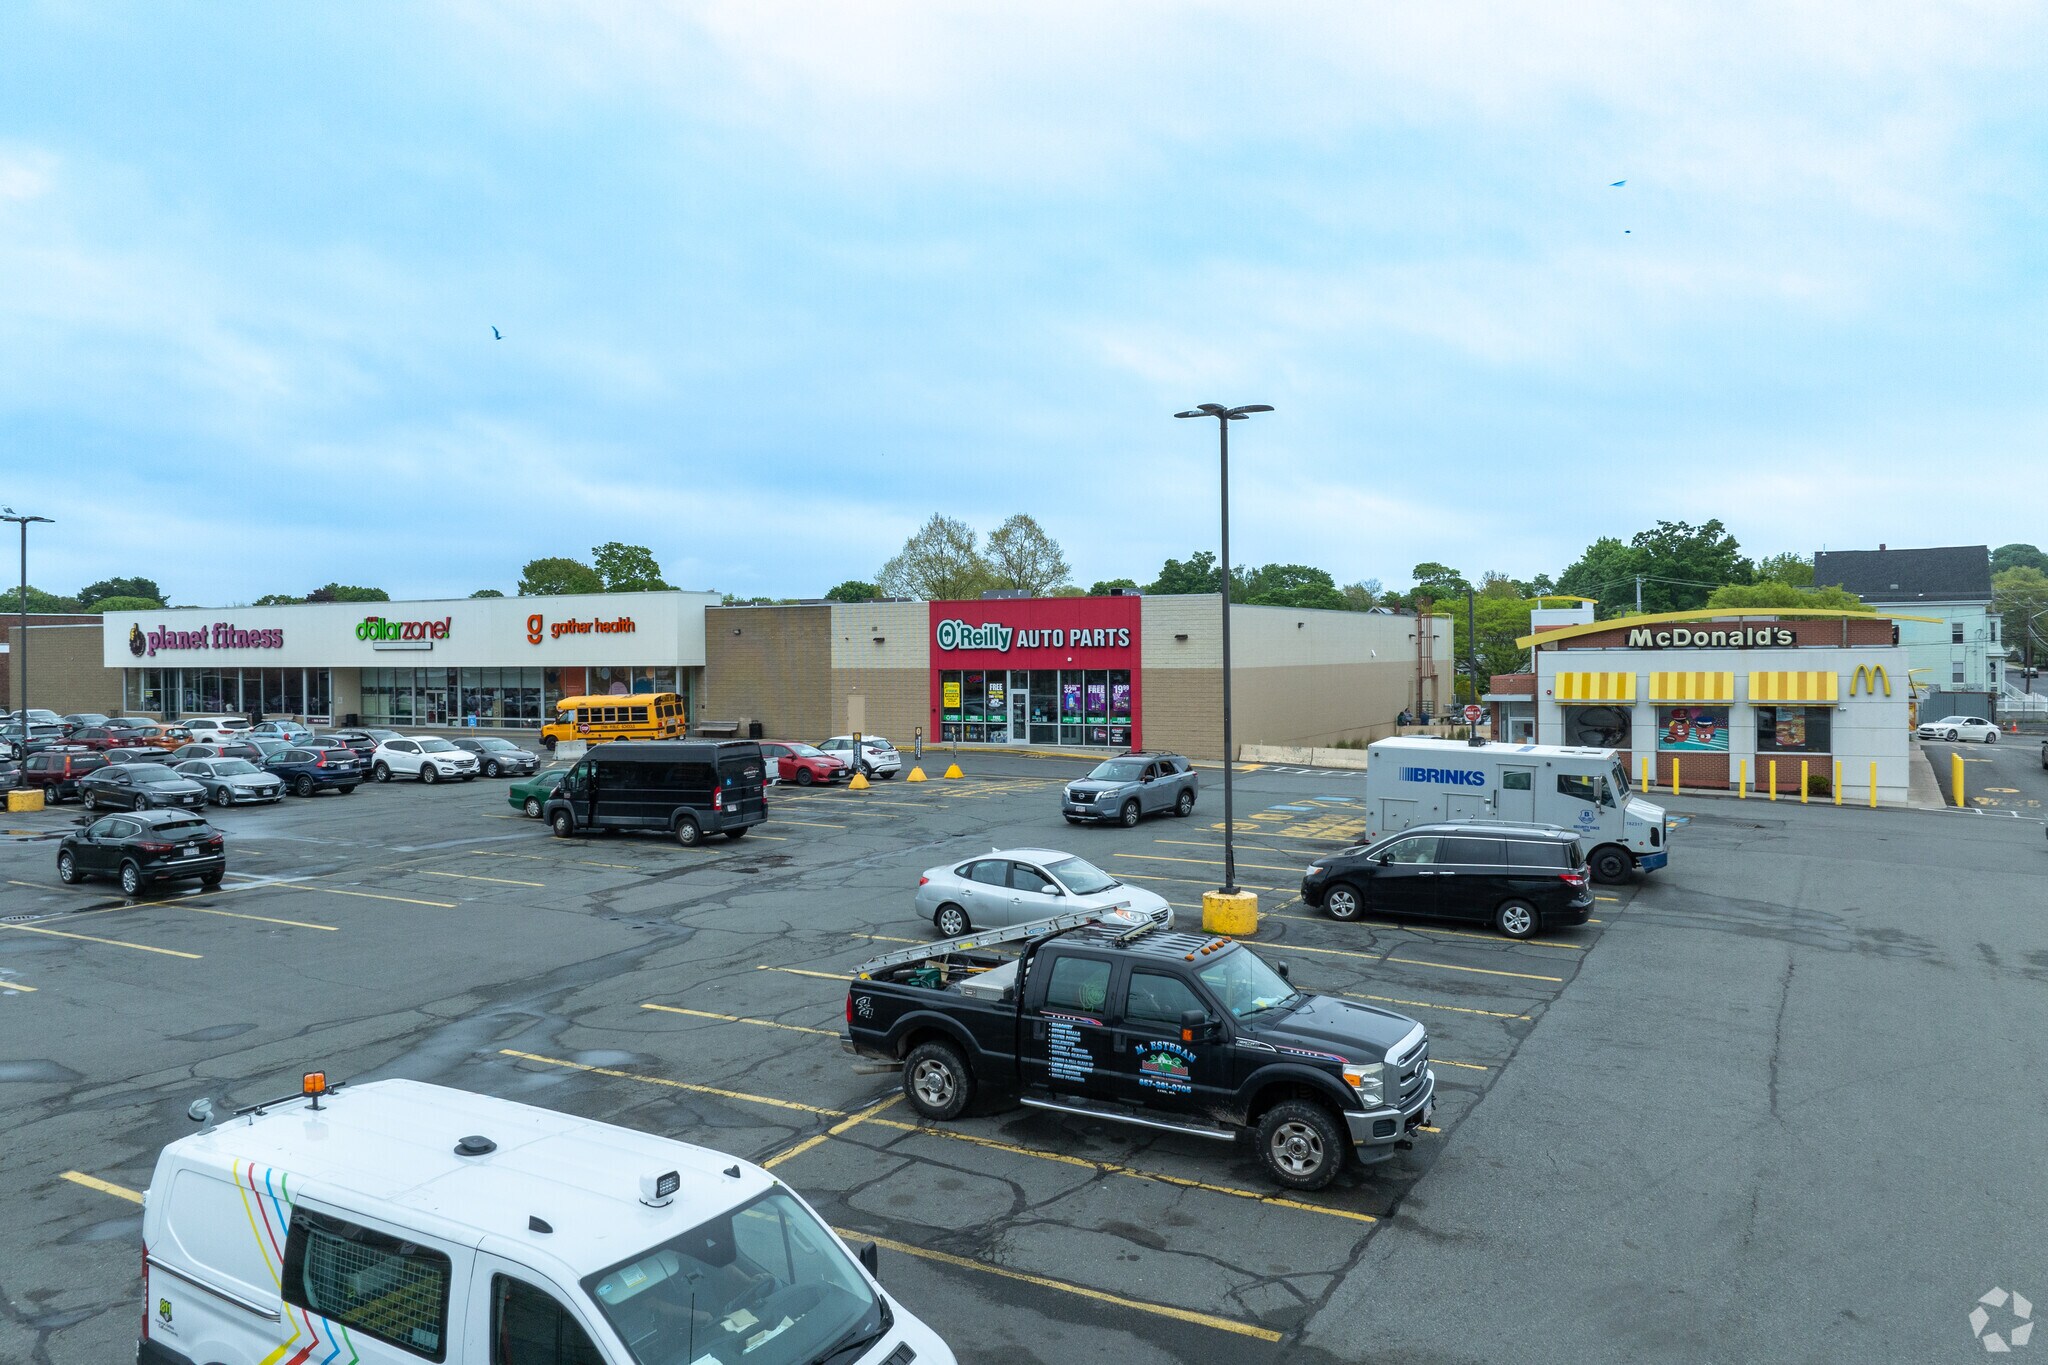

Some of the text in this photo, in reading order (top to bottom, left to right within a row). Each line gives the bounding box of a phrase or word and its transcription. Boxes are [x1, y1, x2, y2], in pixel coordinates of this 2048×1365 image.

[147, 622, 283, 656] planet fitness
[550, 616, 636, 639] gather health
[937, 619, 1131, 652] O'Reilly AUTO PARTS
[1628, 626, 1793, 648] McDonald's
[1412, 767, 1485, 787] BRINKS
[1150, 1040, 1197, 1063] ESTEBAN
[160, 1298, 172, 1316] 811
